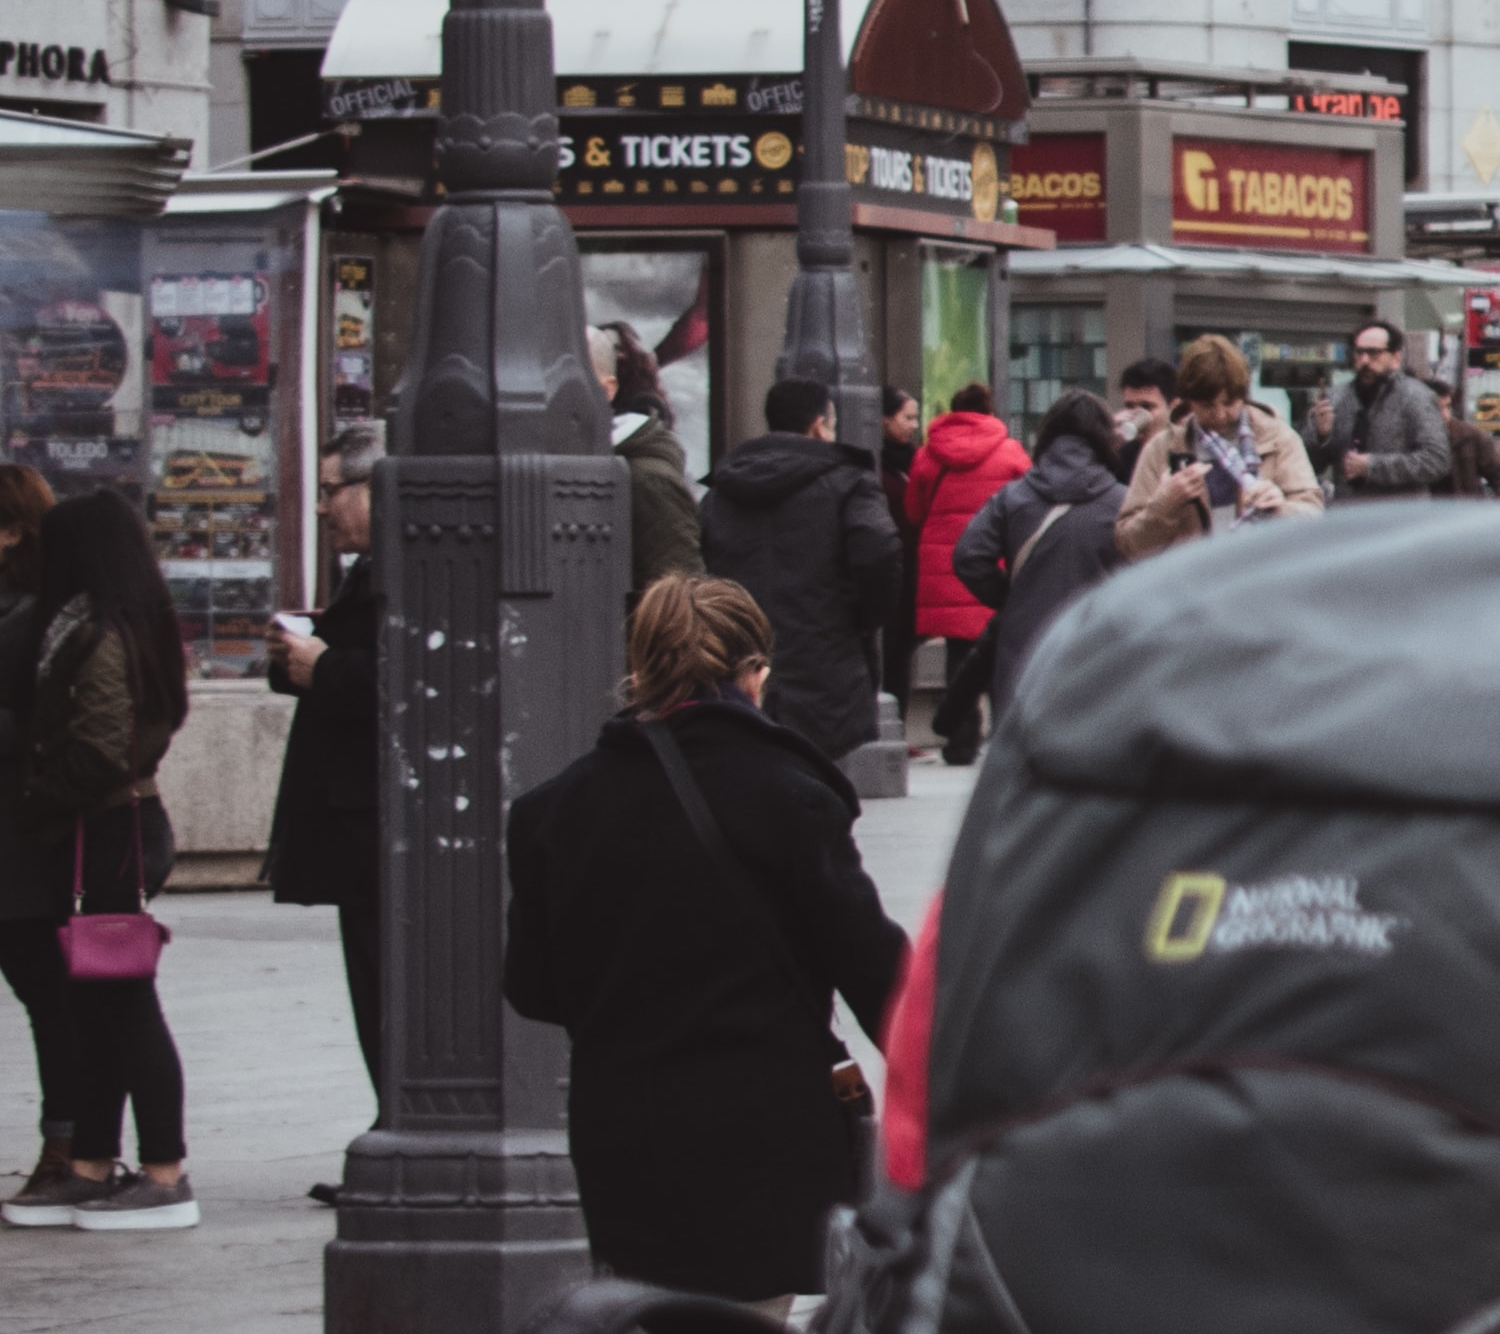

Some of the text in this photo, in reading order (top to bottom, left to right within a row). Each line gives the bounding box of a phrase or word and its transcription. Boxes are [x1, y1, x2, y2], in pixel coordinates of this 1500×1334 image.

[329, 78, 418, 116] OFFICIAL
[747, 80, 804, 112] OFFIC
[584, 135, 612, 167] &
[621, 134, 752, 168] TICKETS
[844, 143, 869, 186] TOP
[871, 145, 913, 192] TOURS
[925, 154, 973, 202] TICKETS
[1011, 171, 1102, 200] BACOS
[1228, 169, 1354, 221] TABACOS
[48, 442, 108, 459] TOLEDO
